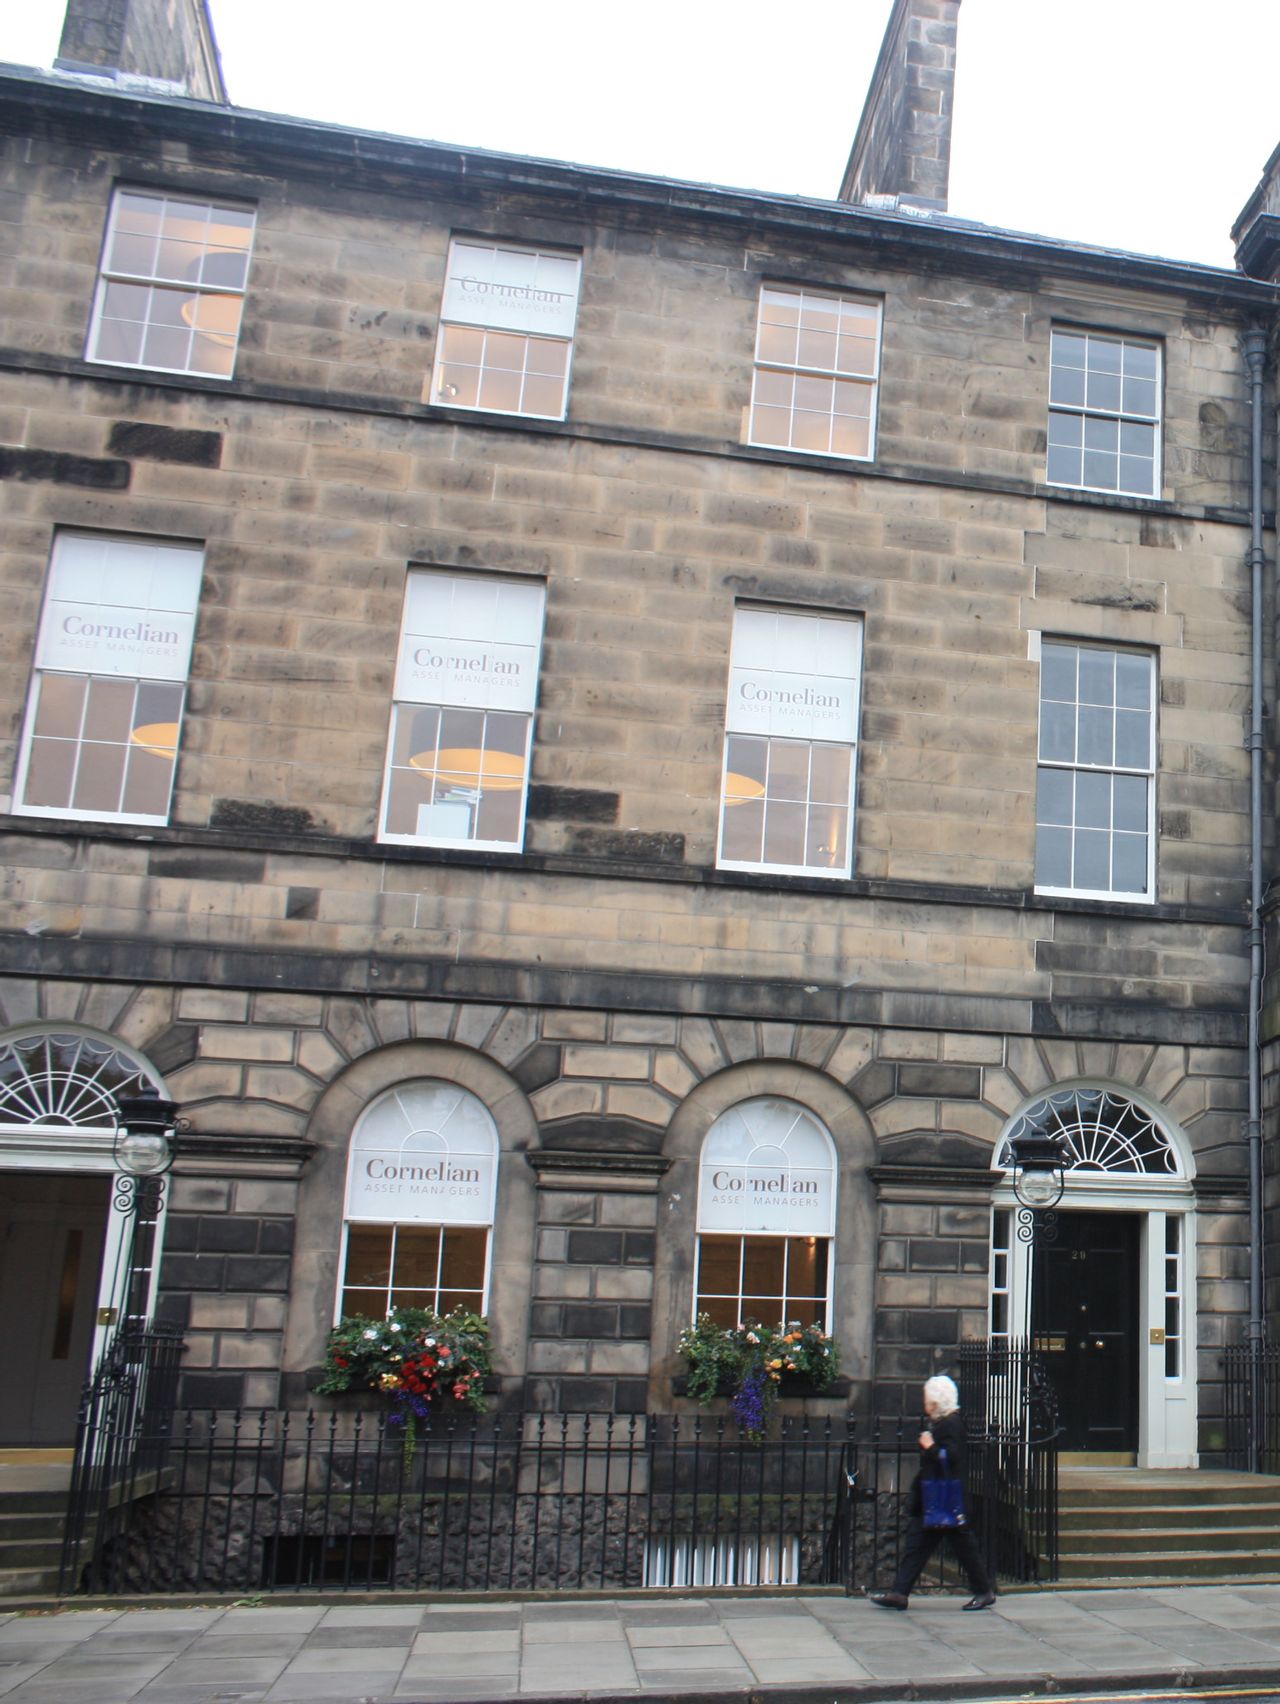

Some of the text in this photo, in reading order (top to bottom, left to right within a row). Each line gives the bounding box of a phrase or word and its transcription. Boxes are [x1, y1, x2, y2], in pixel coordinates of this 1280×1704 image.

[461, 275, 561, 304] Cornelian
[62, 616, 179, 644] Cornelian
[454, 674, 520, 688] MANAGERS
[740, 682, 840, 708] Cornelian
[778, 707, 841, 720] MANAGERS
[366, 1158, 480, 1182] Cornelian
[364, 1183, 480, 1197] ASSET MANAGERS
[711, 1195, 819, 1208] ASSE MANAGERS
